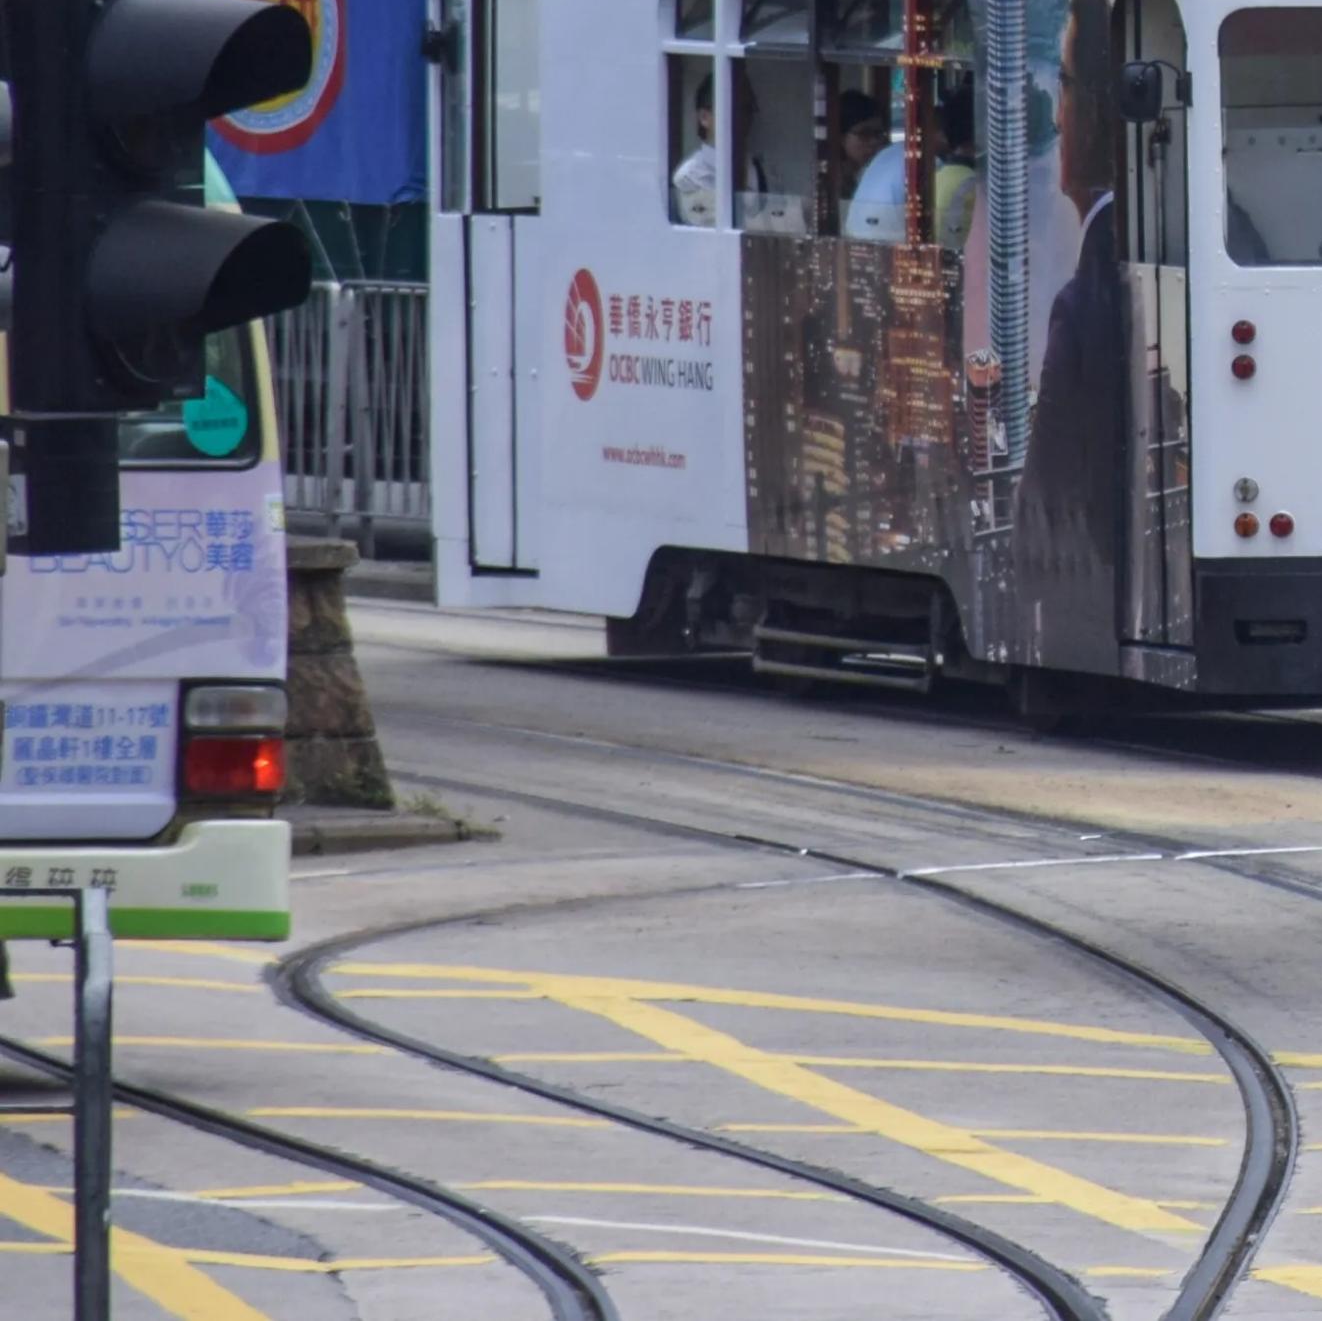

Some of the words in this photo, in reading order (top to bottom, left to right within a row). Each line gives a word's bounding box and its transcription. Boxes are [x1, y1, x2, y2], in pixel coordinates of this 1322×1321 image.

[609, 354, 640, 384] OCBC
[641, 356, 675, 388] WING
[678, 361, 714, 391] HANG
